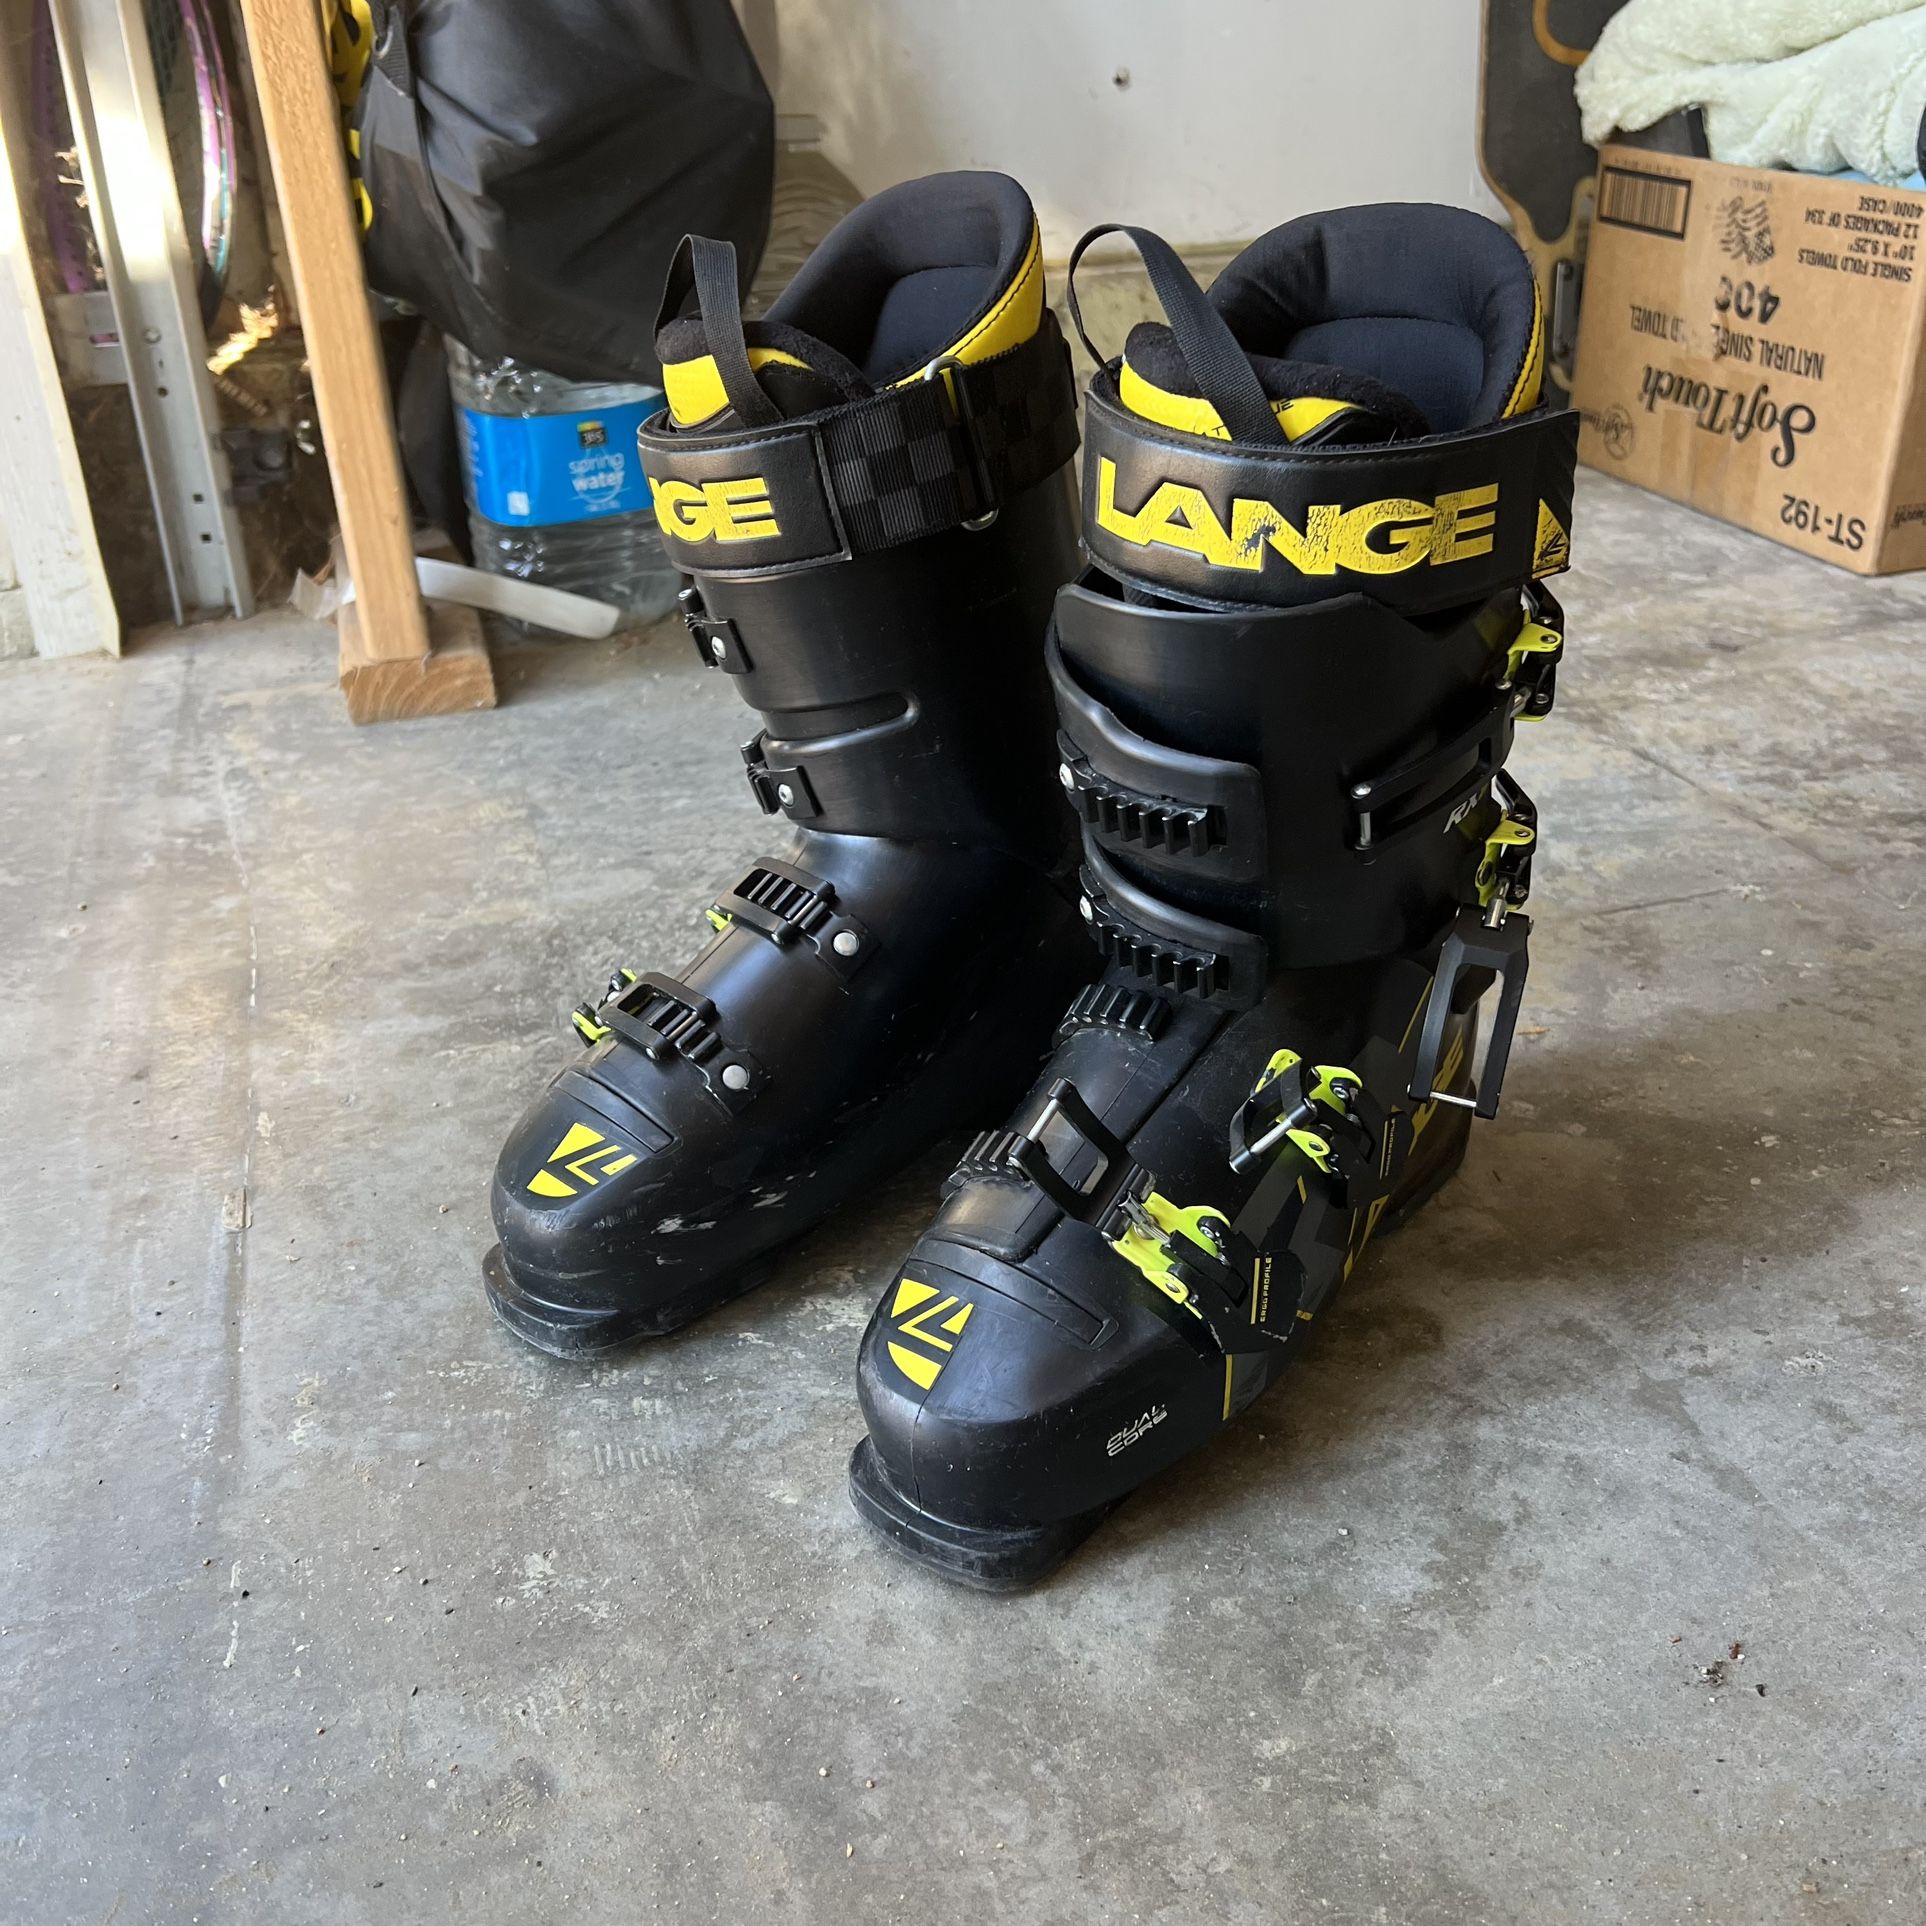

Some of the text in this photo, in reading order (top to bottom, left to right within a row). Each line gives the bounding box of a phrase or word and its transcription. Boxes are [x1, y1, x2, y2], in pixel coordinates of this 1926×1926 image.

[1826, 212, 1841, 228] OF
[1843, 214, 1901, 237] PACKAGES
[1797, 249, 1912, 281] SINGLE FOLD TOWELS
[1628, 304, 1668, 340] TOWEL
[1758, 339, 1826, 382] NATURAL
[568, 452, 625, 476] spring
[572, 470, 625, 492] water
[1097, 456, 1499, 576] LANGE
[1779, 493, 1866, 551] ST-192
